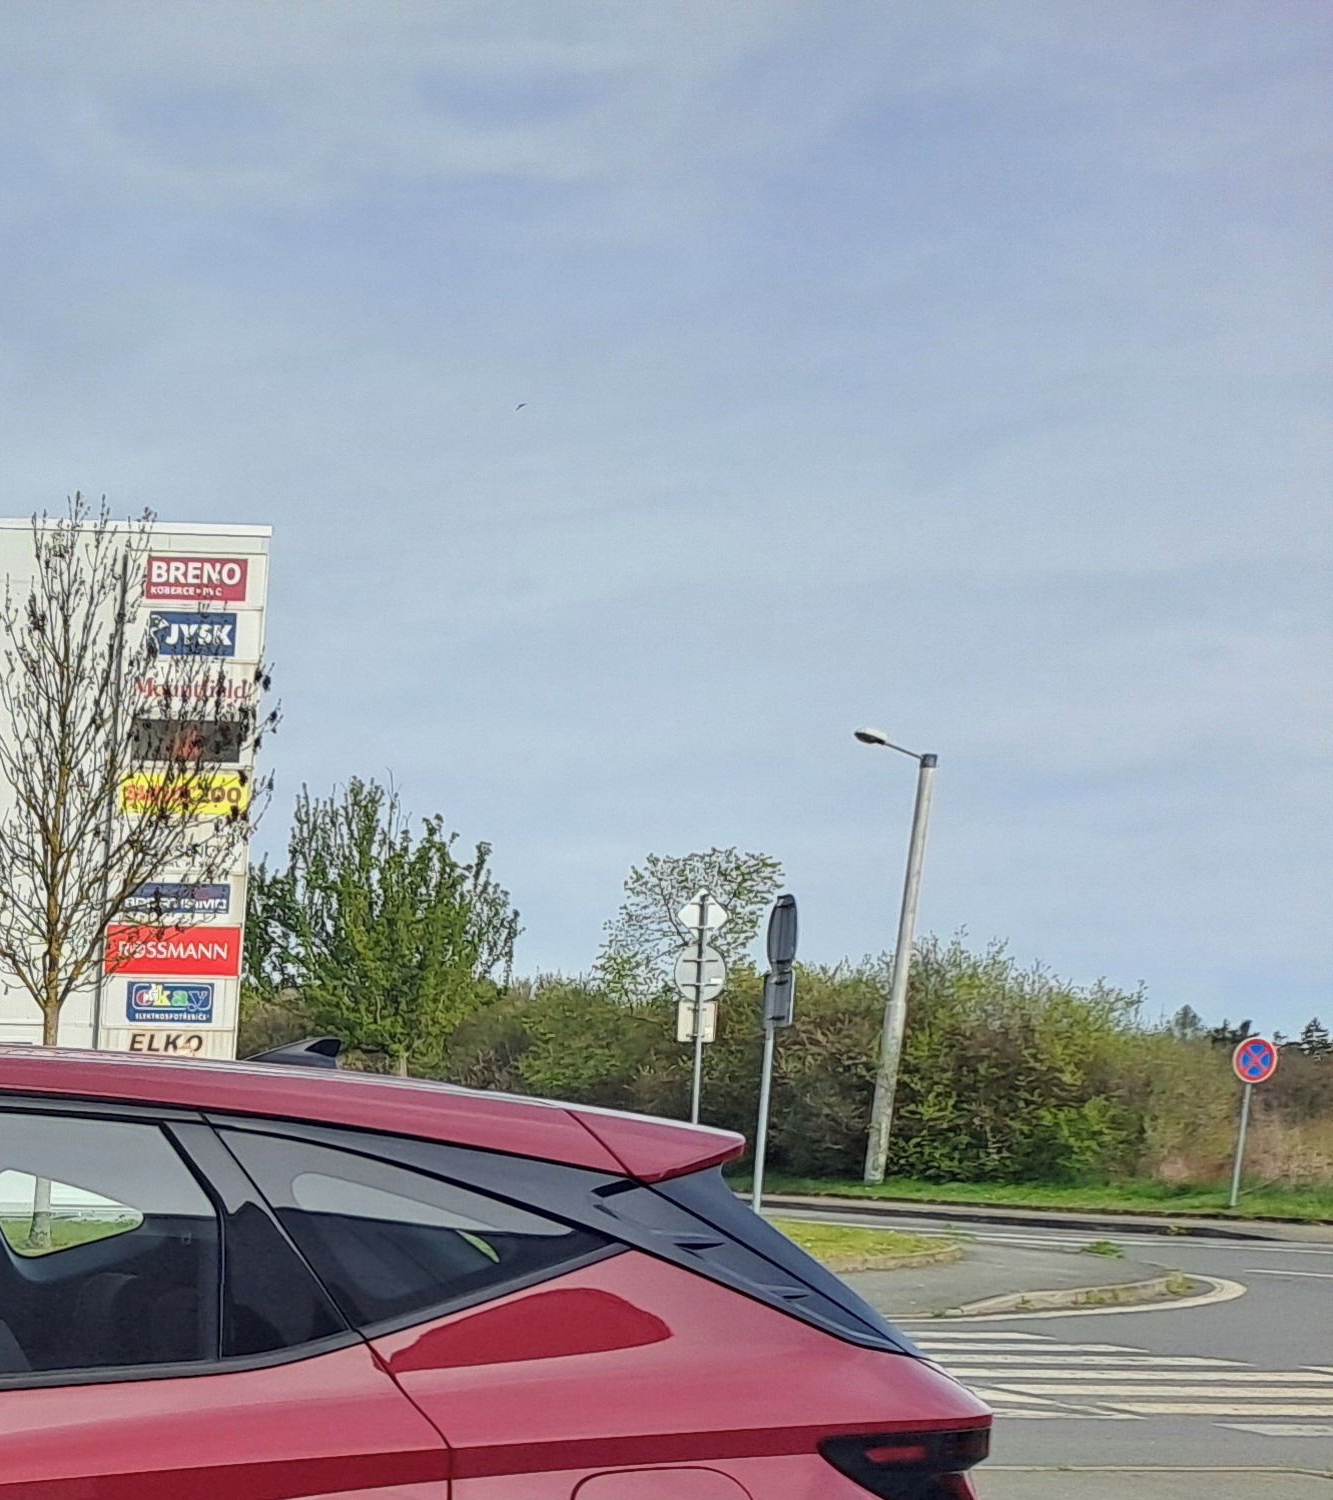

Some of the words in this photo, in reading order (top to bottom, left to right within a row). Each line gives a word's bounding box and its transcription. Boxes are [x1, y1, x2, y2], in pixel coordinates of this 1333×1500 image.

[151, 561, 242, 585] BRENO
[165, 623, 233, 646] JYSK
[133, 677, 247, 699] Mountfild
[117, 940, 229, 960] ROSSMANN
[129, 1034, 203, 1052] ELKO
